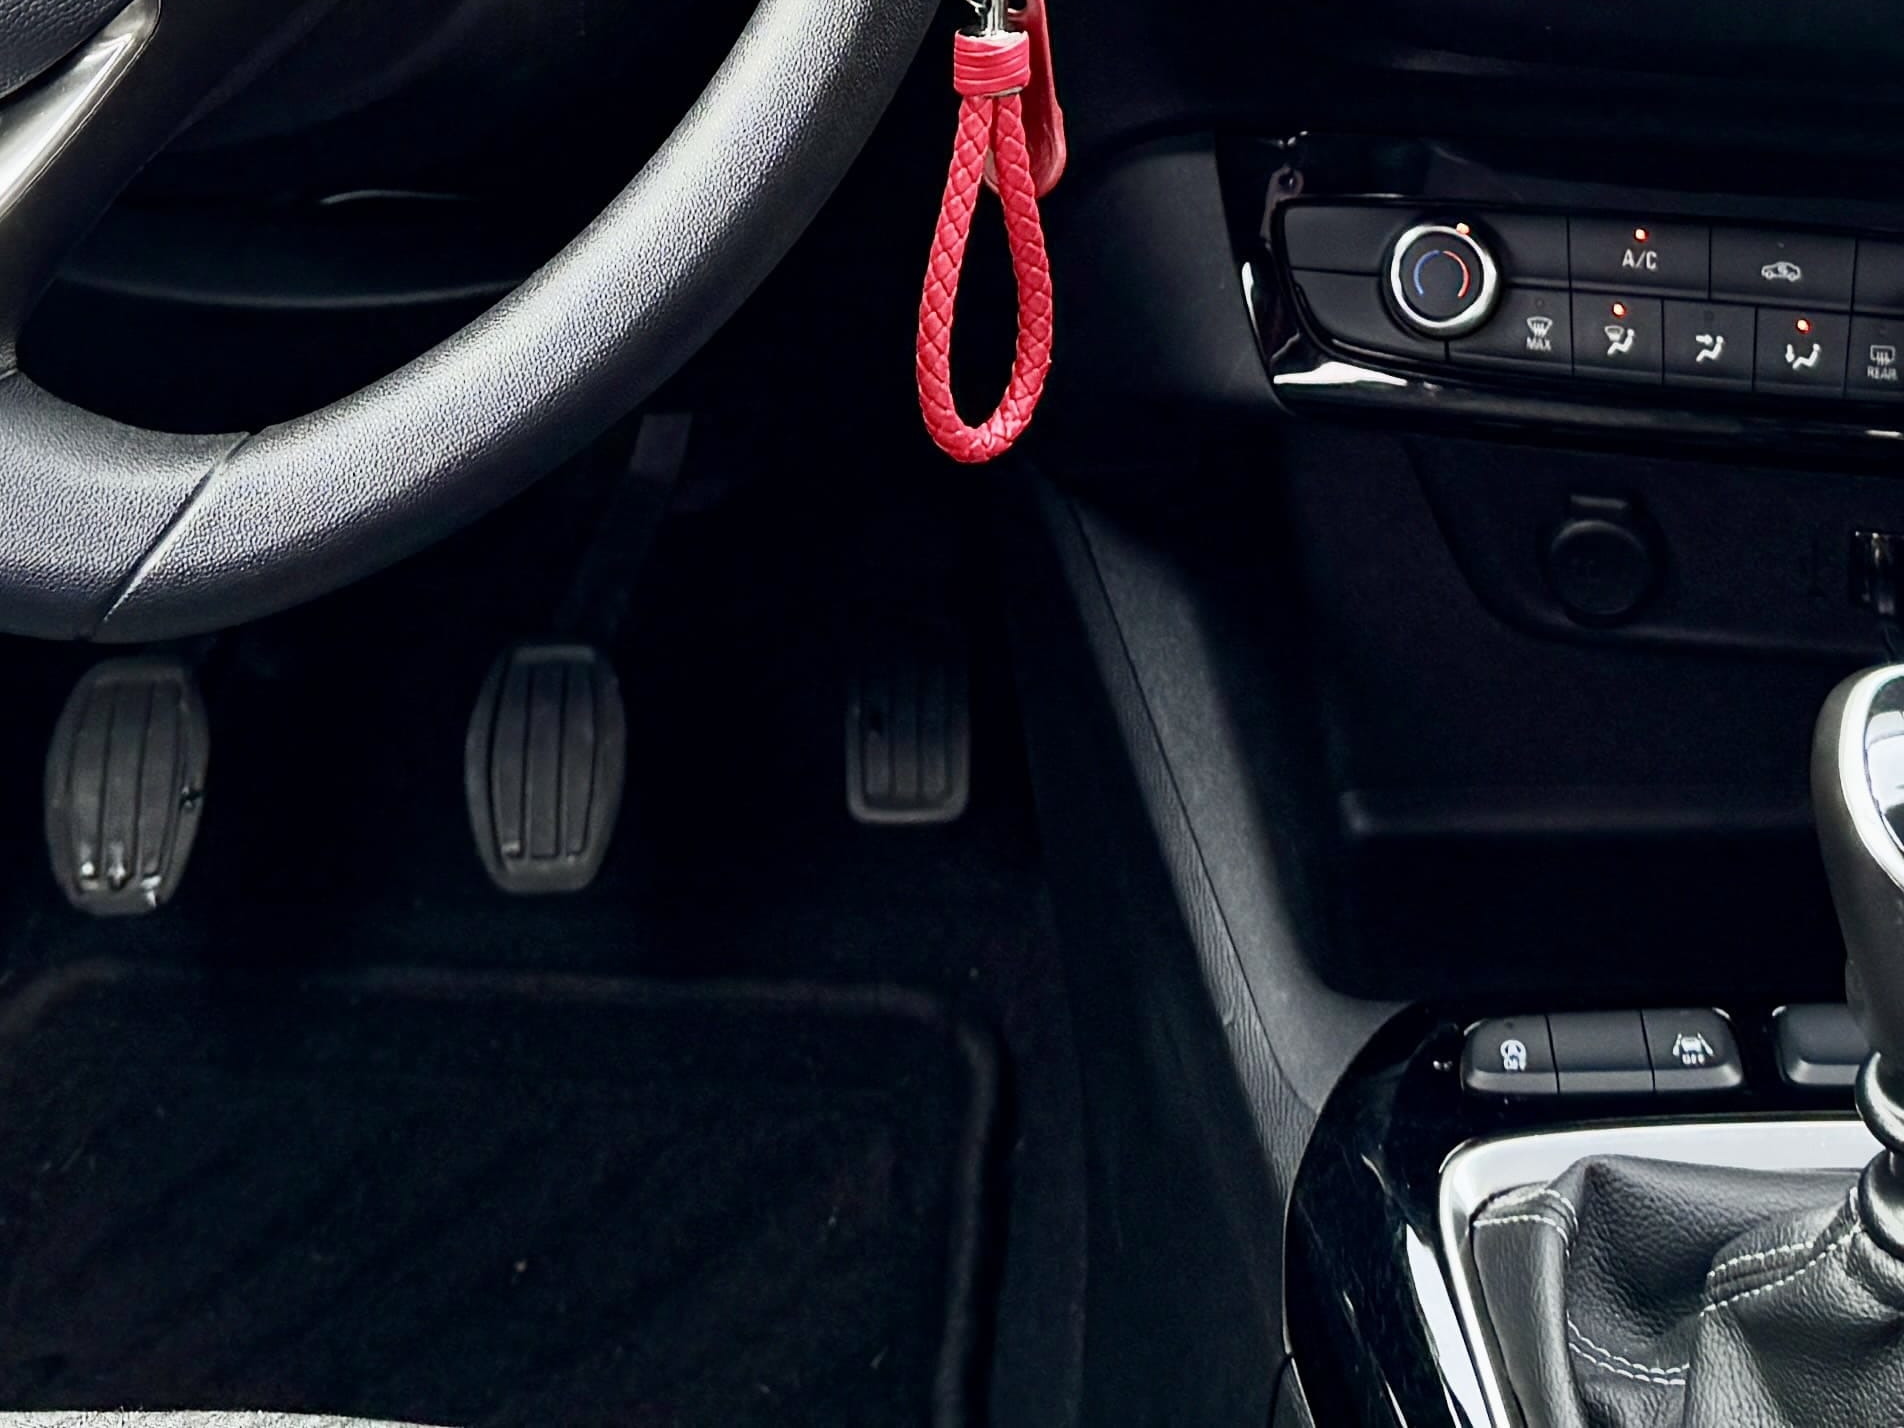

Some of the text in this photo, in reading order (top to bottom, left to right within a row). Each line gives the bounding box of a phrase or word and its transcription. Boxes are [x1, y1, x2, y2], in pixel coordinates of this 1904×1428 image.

[1622, 248, 1658, 271] A/C
[1526, 336, 1552, 351] MAX
[1867, 366, 1898, 381] REAR
